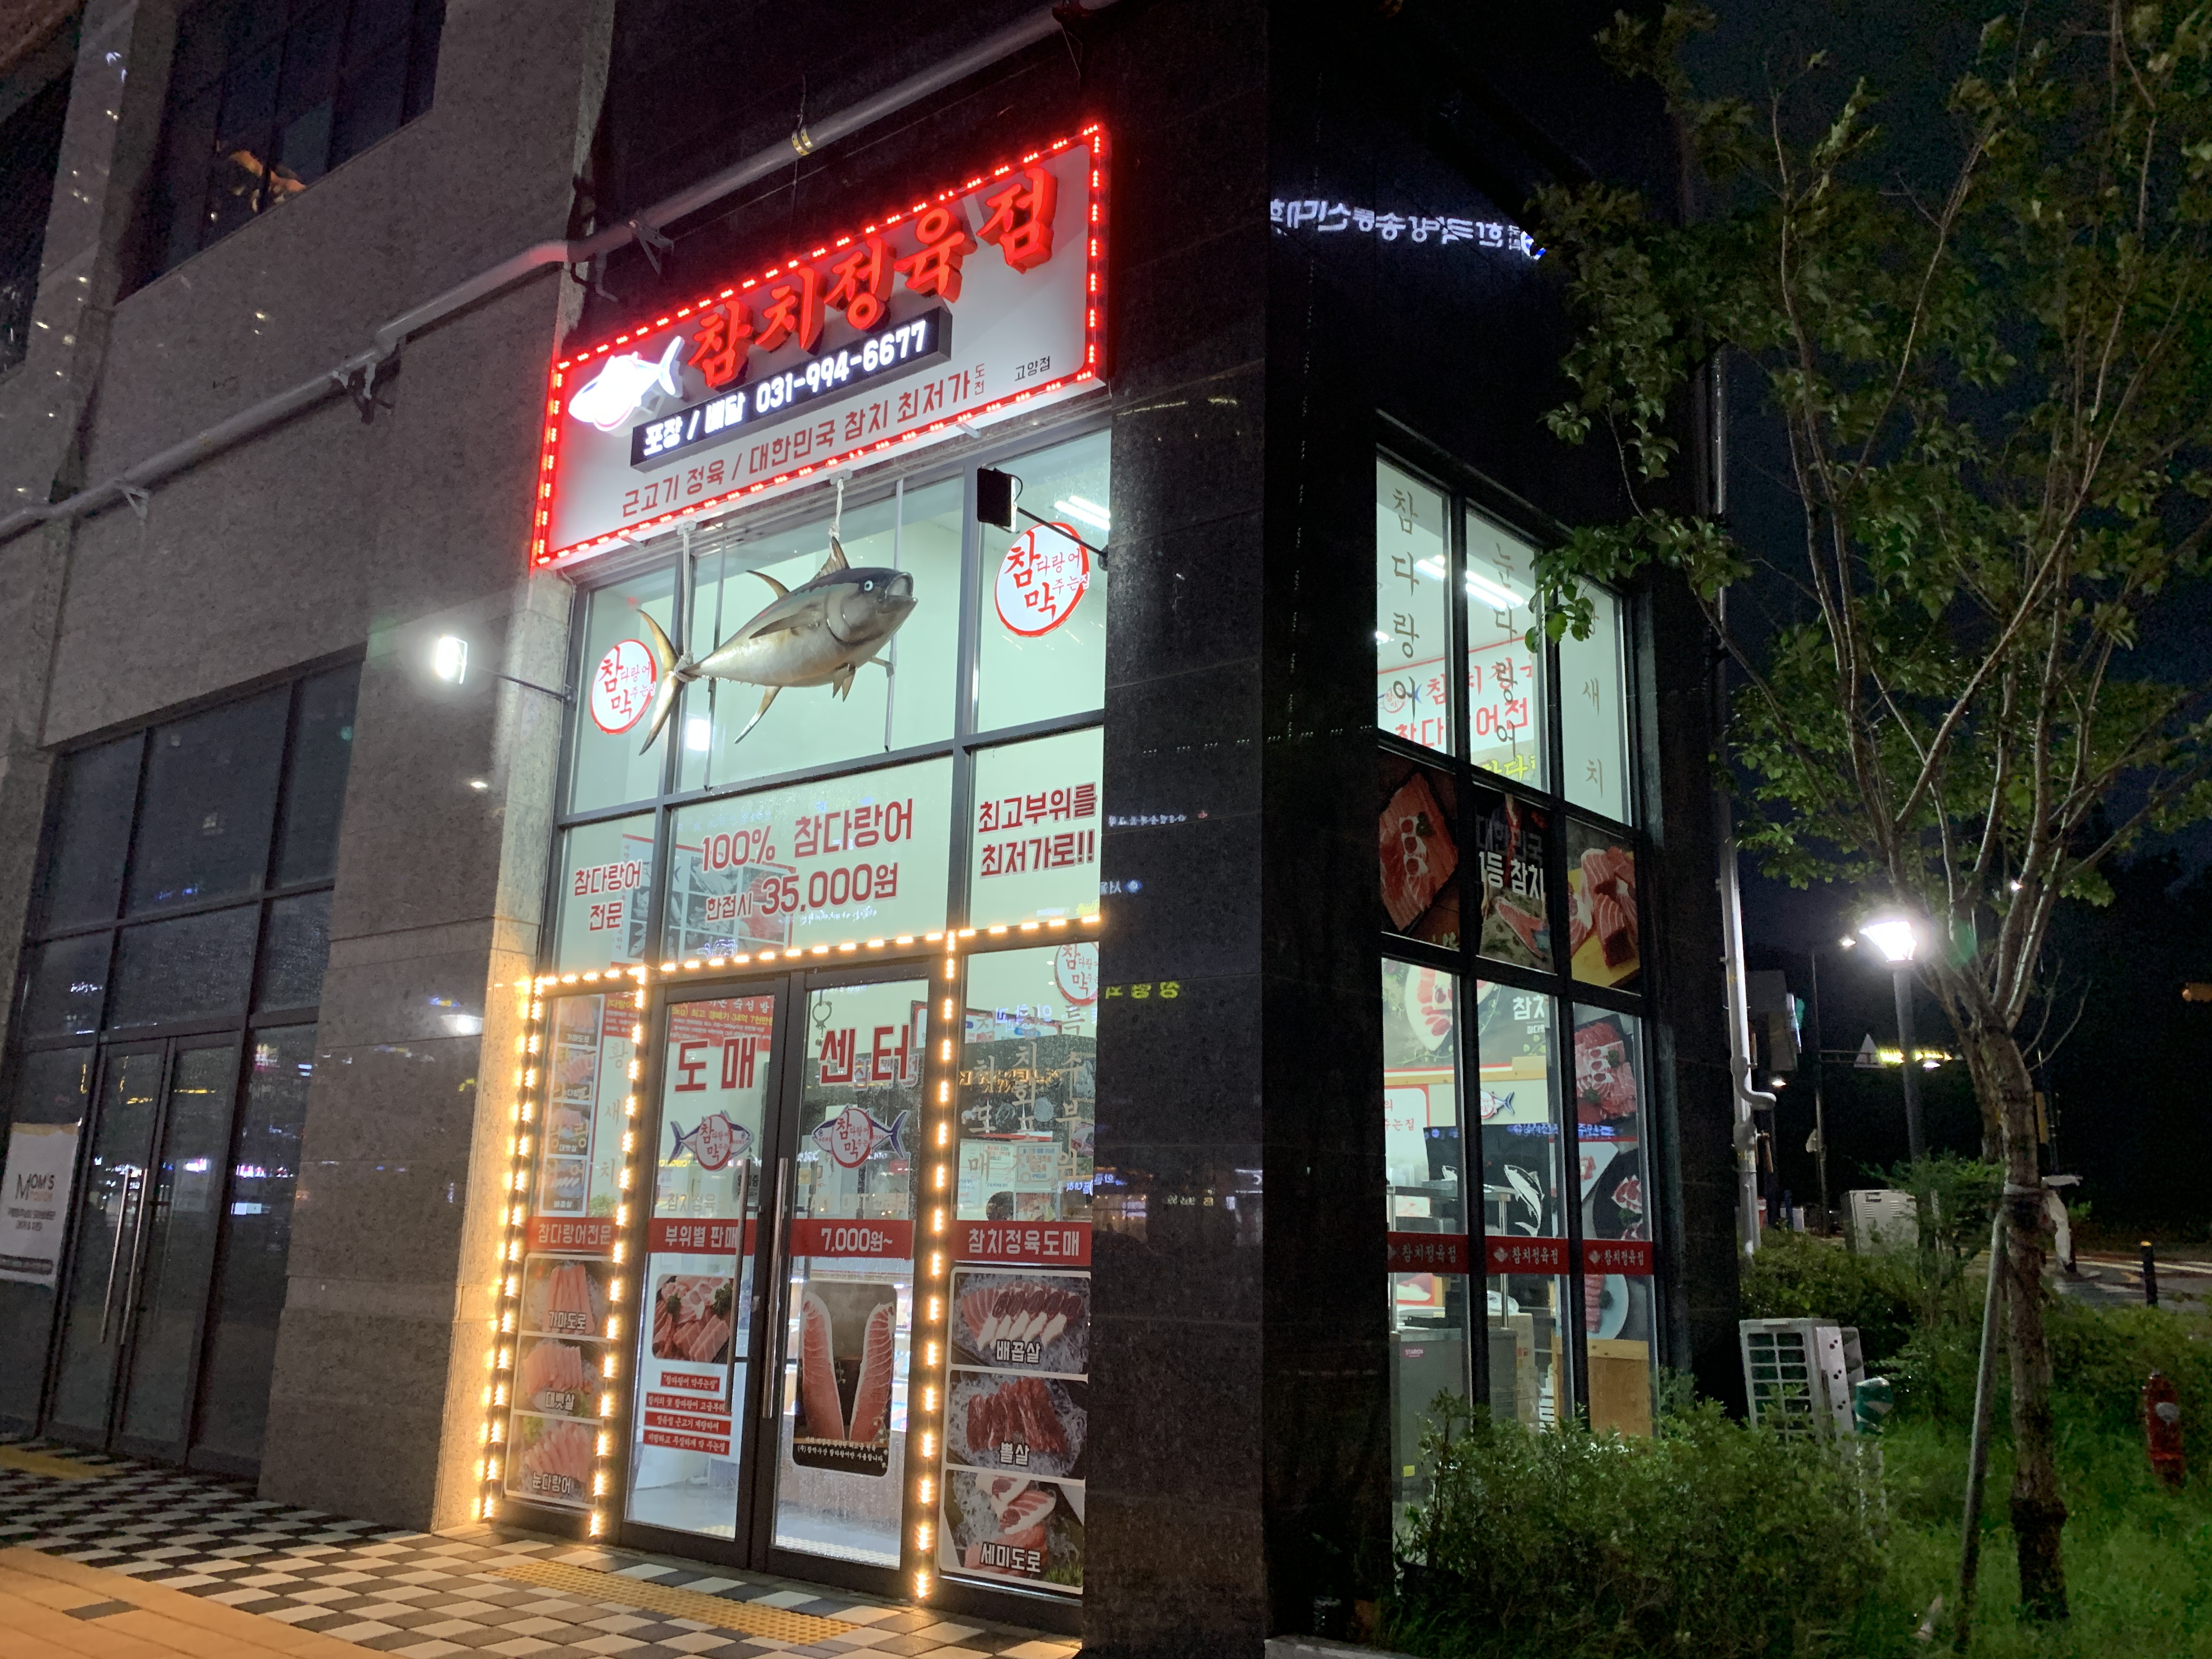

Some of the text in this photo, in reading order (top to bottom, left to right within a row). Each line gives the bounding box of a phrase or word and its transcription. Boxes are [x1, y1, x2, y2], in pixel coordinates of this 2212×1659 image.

[689, 167, 1059, 388] 참치정육점
[755, 320, 927, 413] 031-994-6677
[1014, 356, 1052, 382] 고양점
[622, 476, 679, 518] 근고기
[686, 456, 725, 493] 정육
[749, 424, 835, 476] 대한민국
[845, 404, 888, 444] 참치
[898, 370, 970, 425] 최저가
[978, 782, 1097, 833] 최고부위를
[702, 798, 912, 873] 100% 참다랑어
[980, 829, 1095, 877] 최저가로!!
[574, 859, 641, 896] 참다랑어
[1510, 859, 1544, 900] 참치
[590, 901, 623, 930] 전문
[706, 891, 753, 921] 한접시
[674, 1037, 757, 1093] 도매
[819, 1024, 910, 1086] 센터
[538, 1224, 611, 1245] 참다랑어전문
[665, 1226, 706, 1248] 부위별
[969, 1228, 1079, 1256] 참치정육도매
[549, 1311, 586, 1330] 가마도로
[996, 1340, 1041, 1364] 배꼽살
[545, 1391, 575, 1410] 대뱃살
[532, 1472, 572, 1494] 눈다랑어
[980, 1543, 1041, 1573] 세미도로
